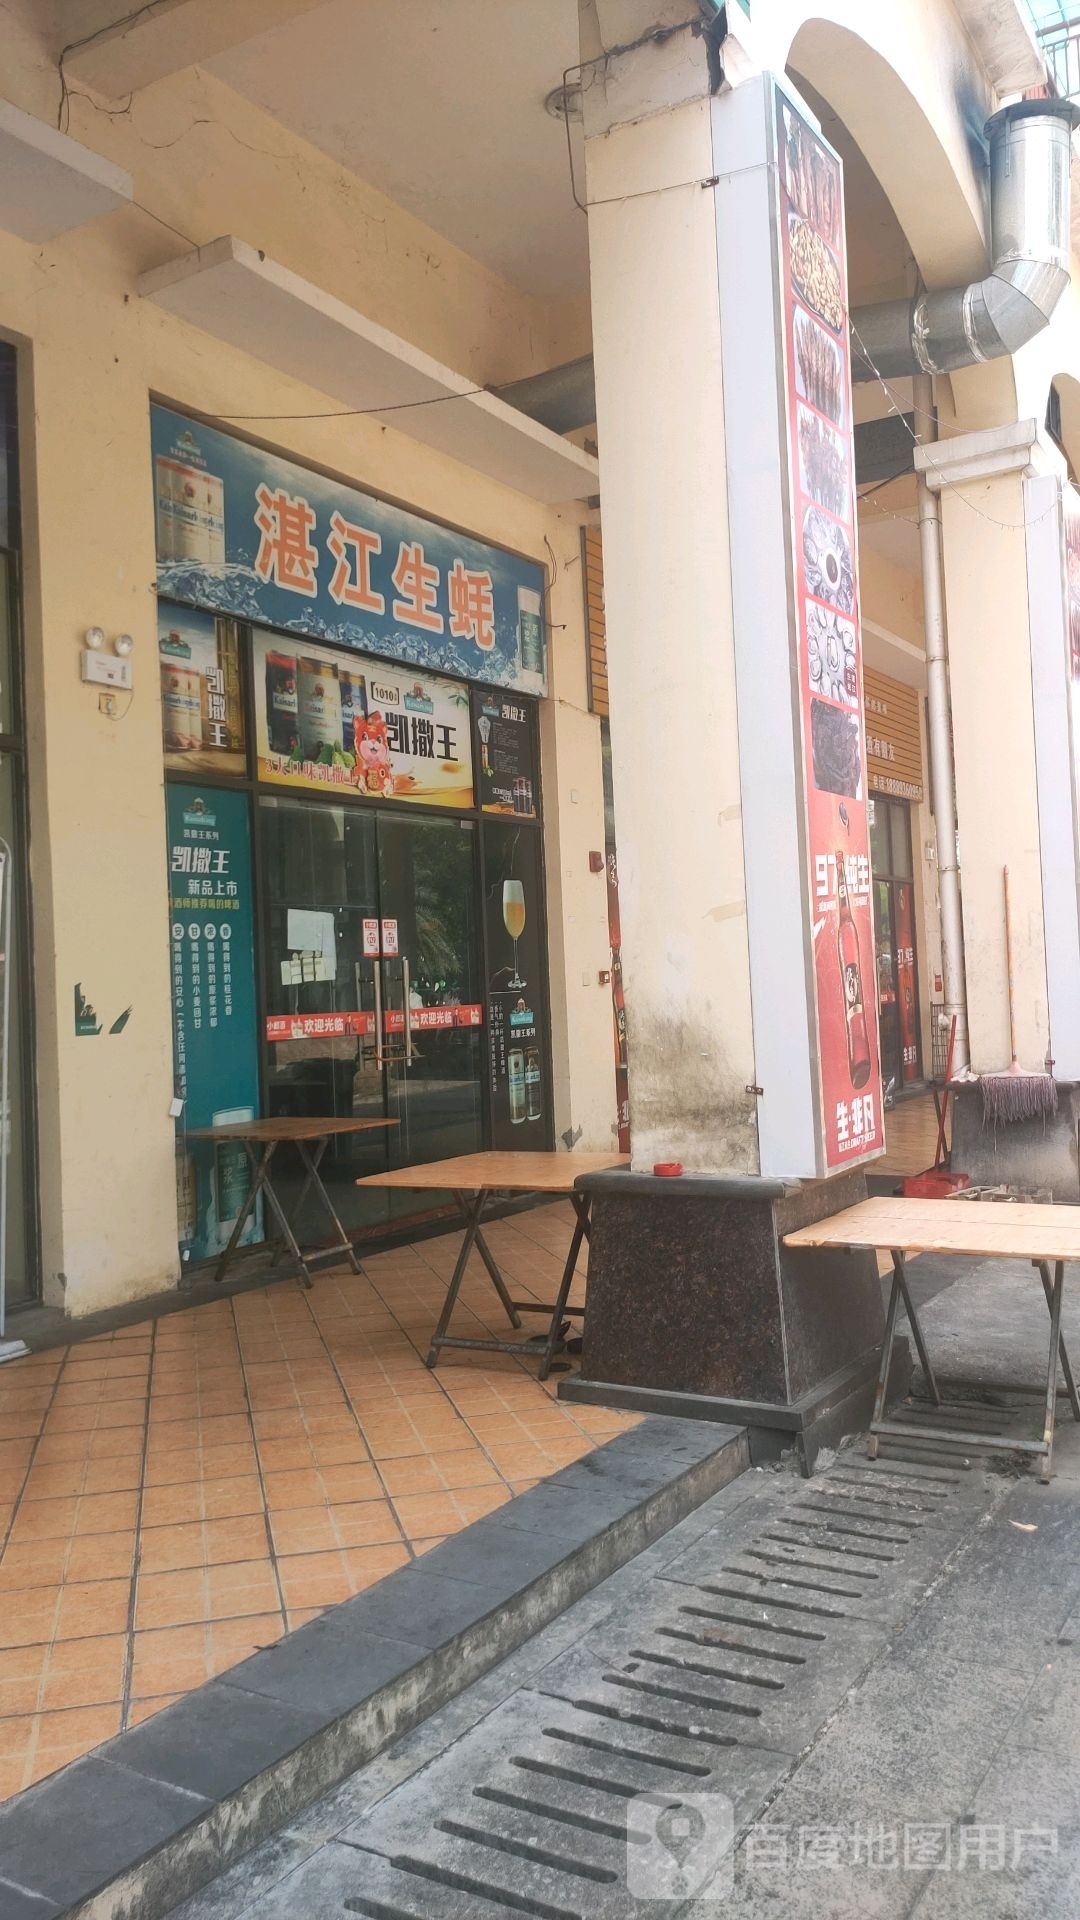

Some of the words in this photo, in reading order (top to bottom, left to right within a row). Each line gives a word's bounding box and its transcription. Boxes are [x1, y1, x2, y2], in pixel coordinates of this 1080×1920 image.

[254, 482, 496, 650] 湛江生蚝
[375, 687, 394, 702] 1010
[205, 666, 227, 748] 凯撒王
[501, 704, 527, 723] 凯撒王
[384, 712, 459, 762] 凯撒王
[171, 845, 231, 874] 凯撒王
[187, 879, 238, 897] 新品上市
[304, 1017, 344, 1033] 欢迎光临
[420, 1010, 452, 1025] 欢迎光临
